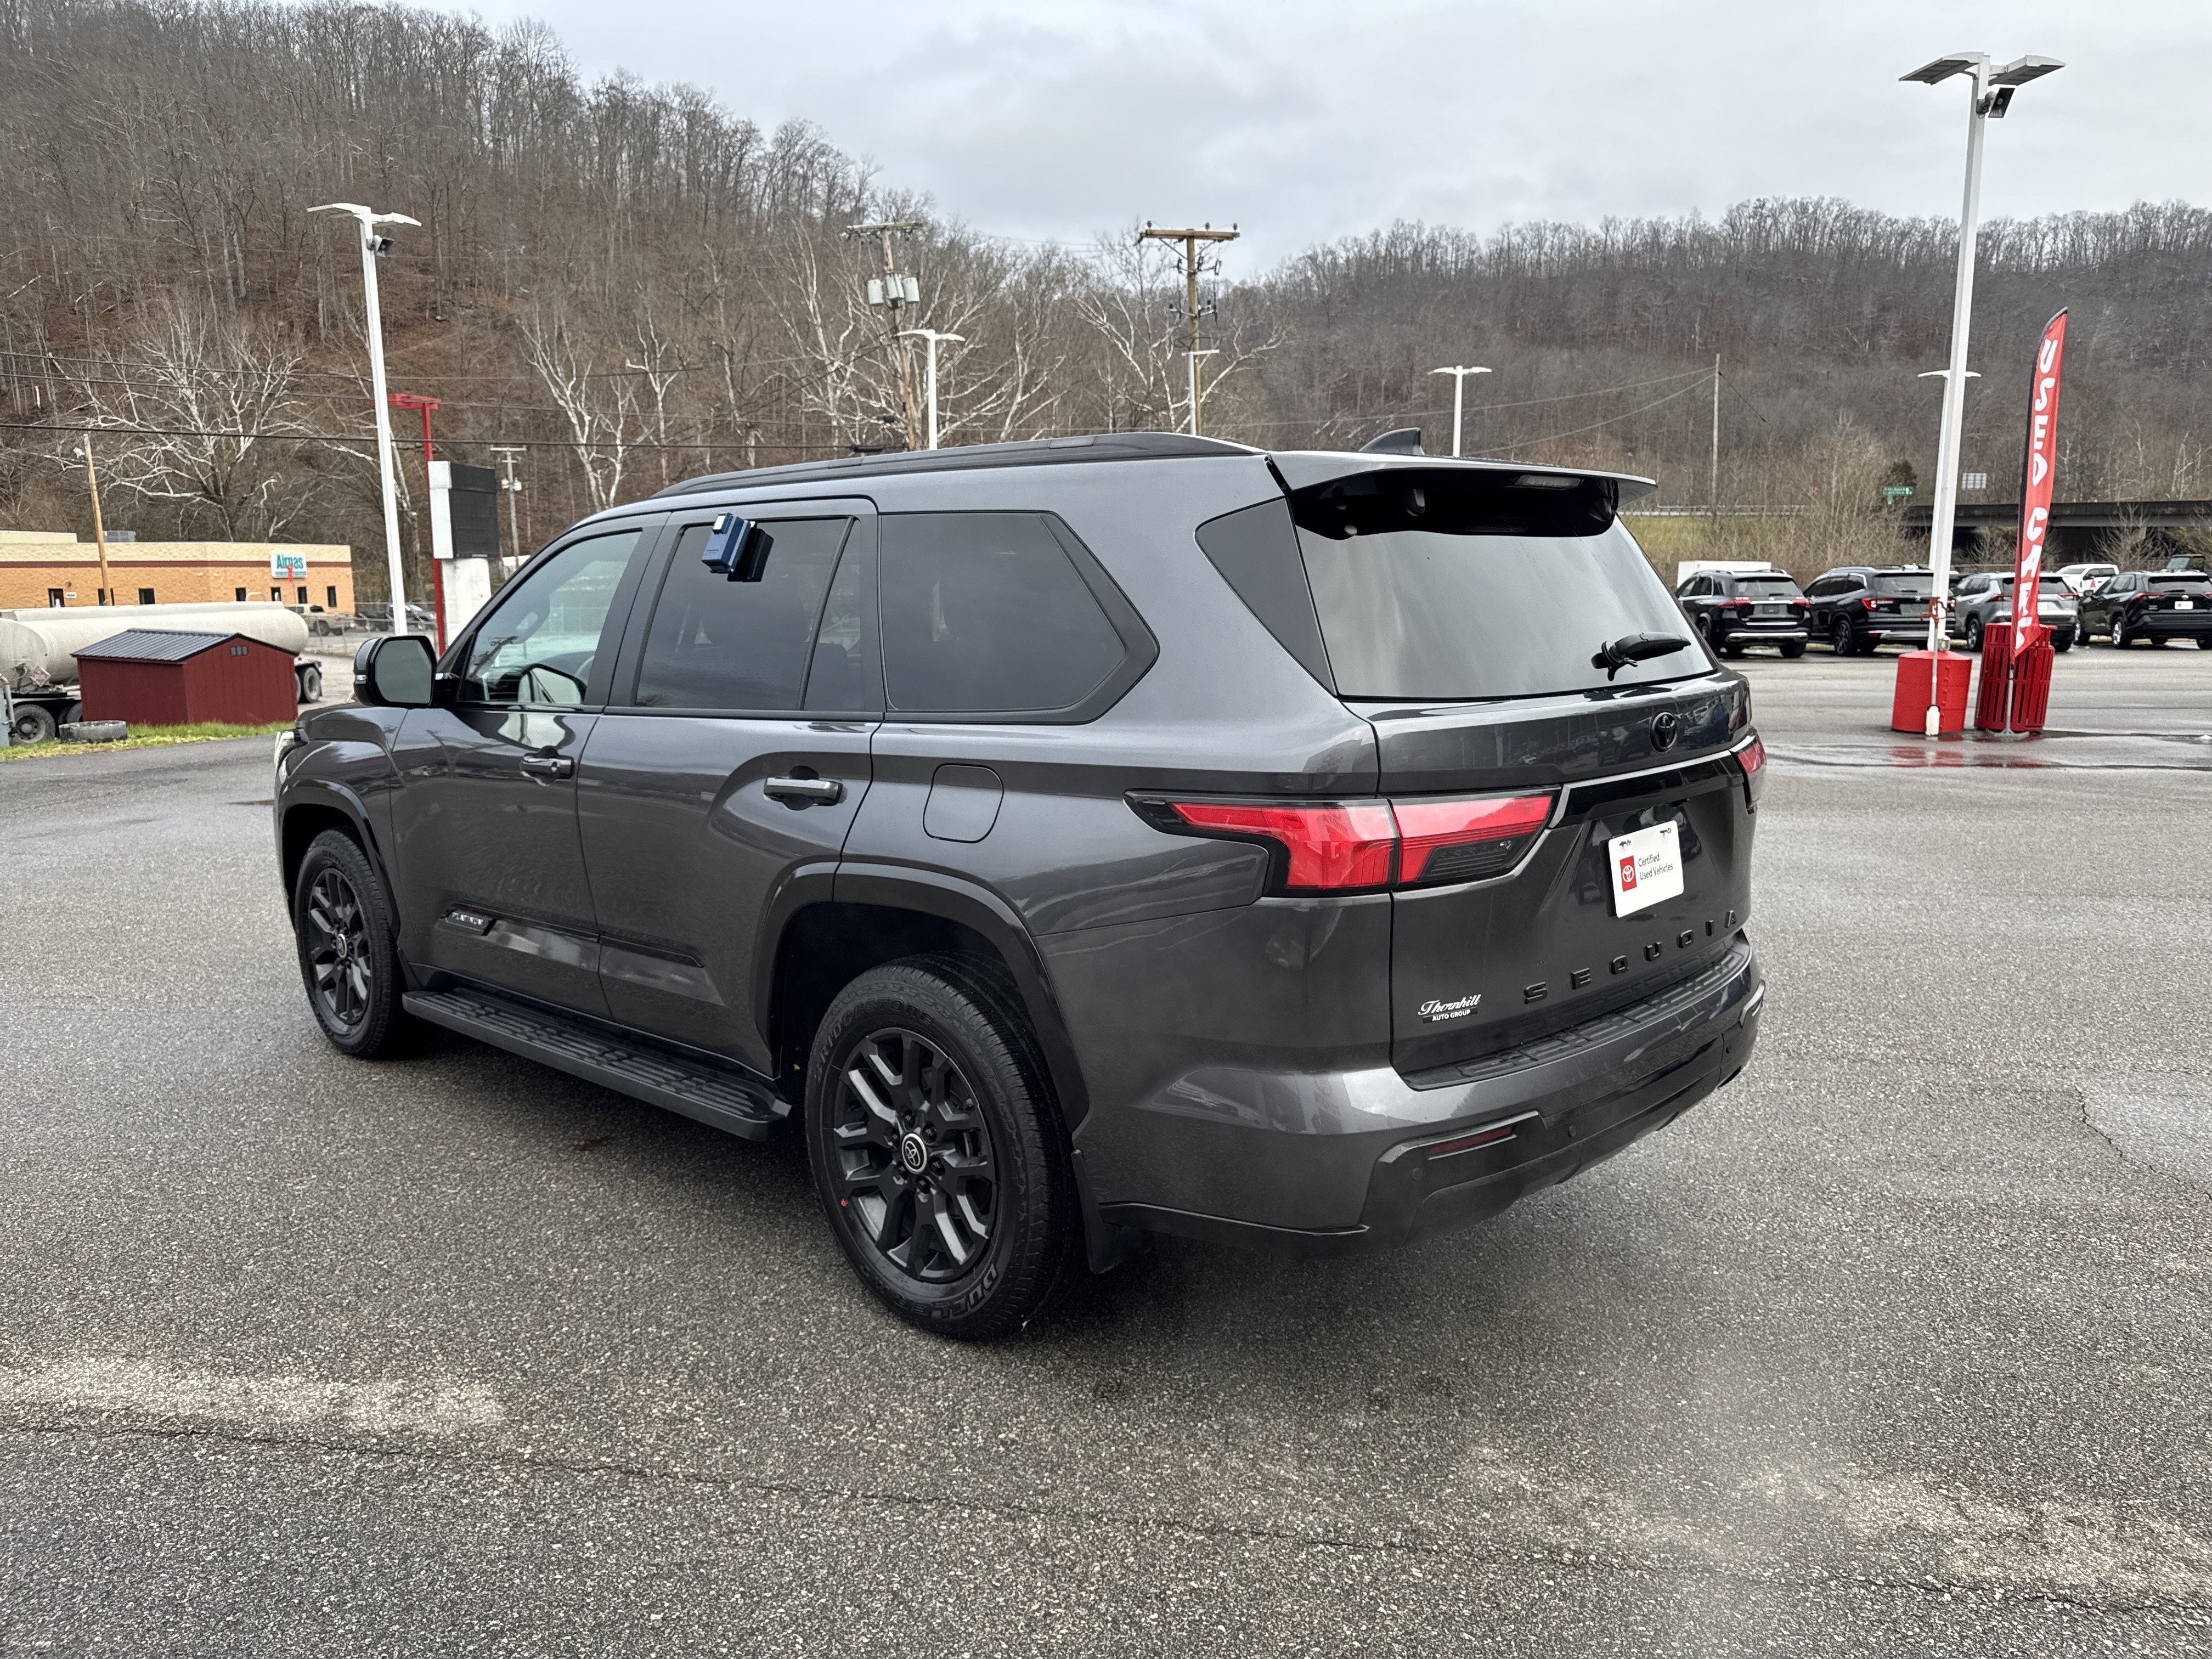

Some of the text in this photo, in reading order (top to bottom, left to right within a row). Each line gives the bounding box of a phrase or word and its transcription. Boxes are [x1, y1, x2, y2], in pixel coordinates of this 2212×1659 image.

[2032, 338, 2058, 487] USED
[1638, 852, 1660, 867] Certified
[1639, 862, 1673, 880] Used Vehicles
[1523, 910, 1738, 1005] SEQUOIA
[1418, 994, 1481, 1015] Thornhill
[1450, 1009, 1471, 1018] GROUP
